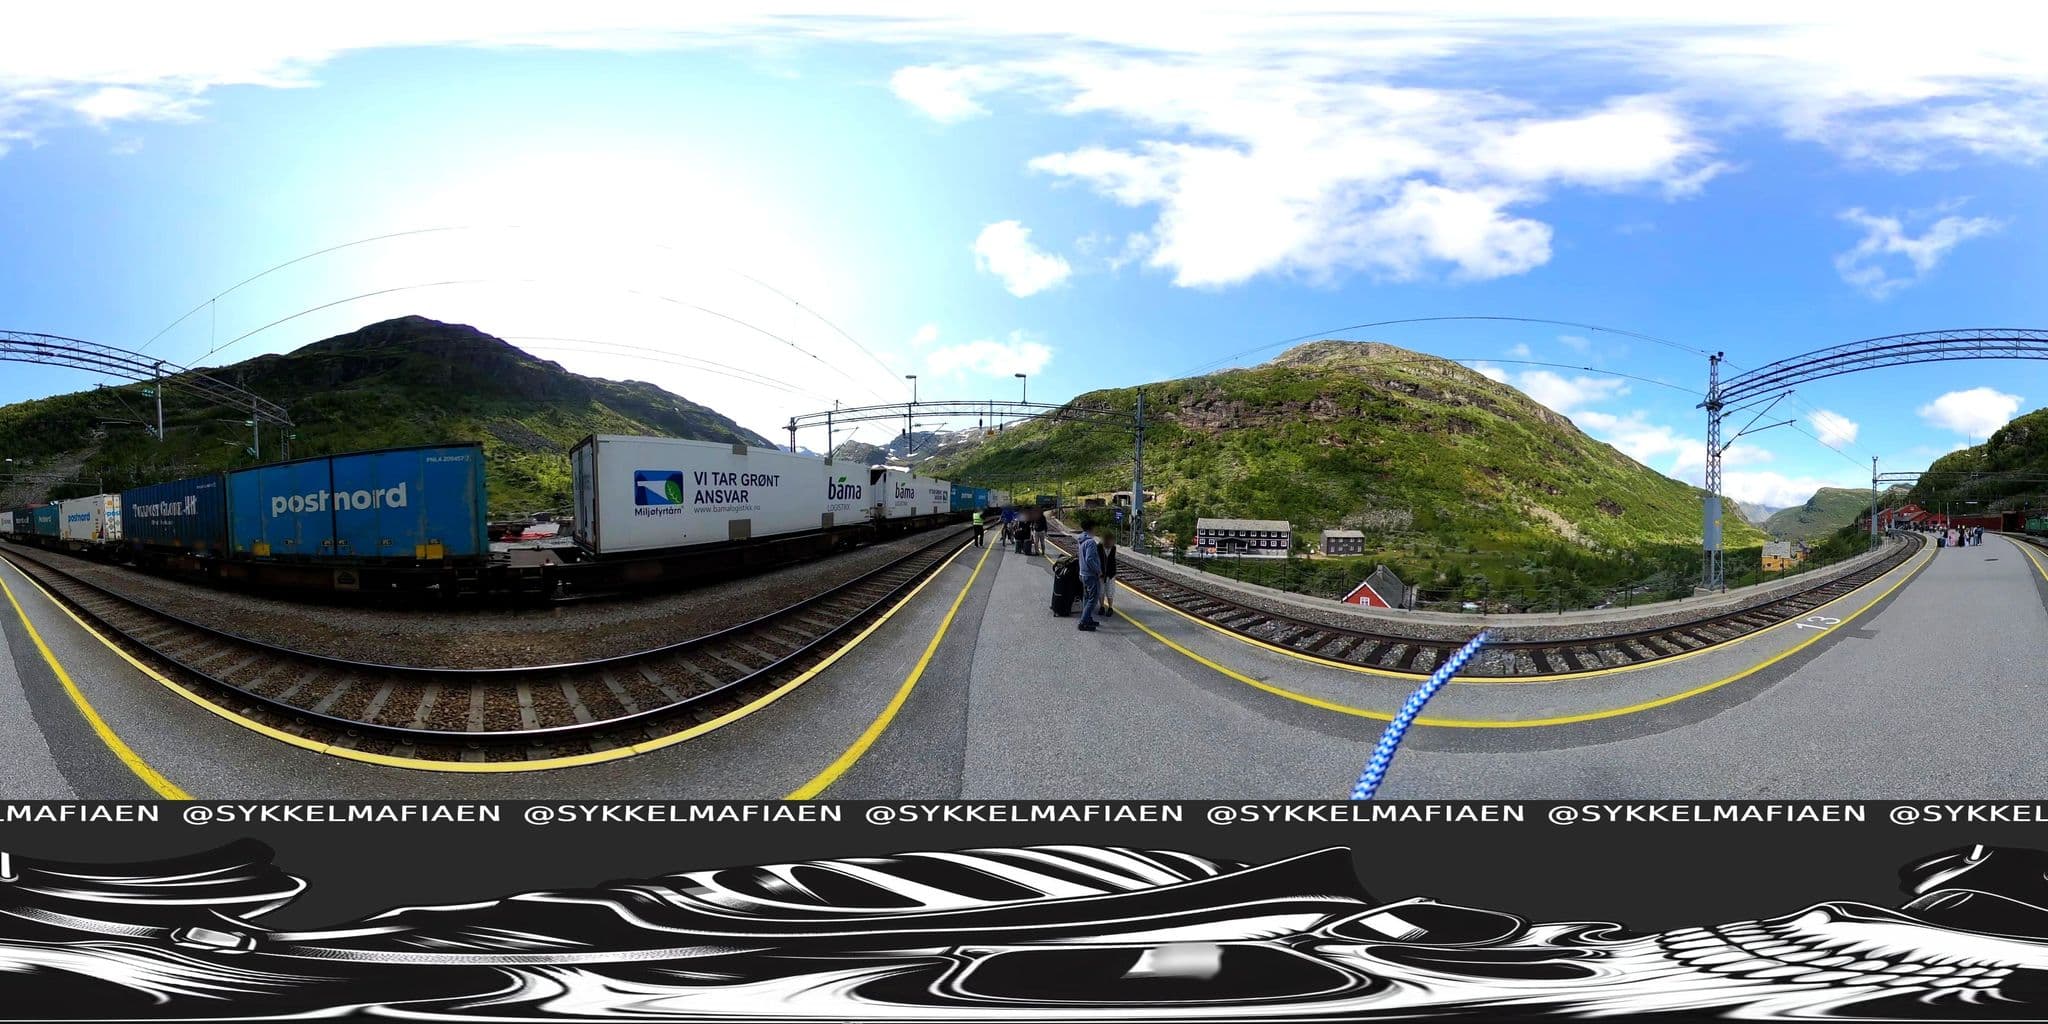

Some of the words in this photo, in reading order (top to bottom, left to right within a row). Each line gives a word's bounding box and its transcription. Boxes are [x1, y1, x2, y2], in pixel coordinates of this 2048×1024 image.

[694, 471, 708, 486] VI
[712, 472, 737, 487] TAR
[741, 473, 780, 488] GRØNT
[271, 481, 408, 518] postnord
[694, 490, 749, 505] ANSVAR
[634, 506, 682, 518] Miljøfyrtårn
[1795, 615, 1841, 630] 13
